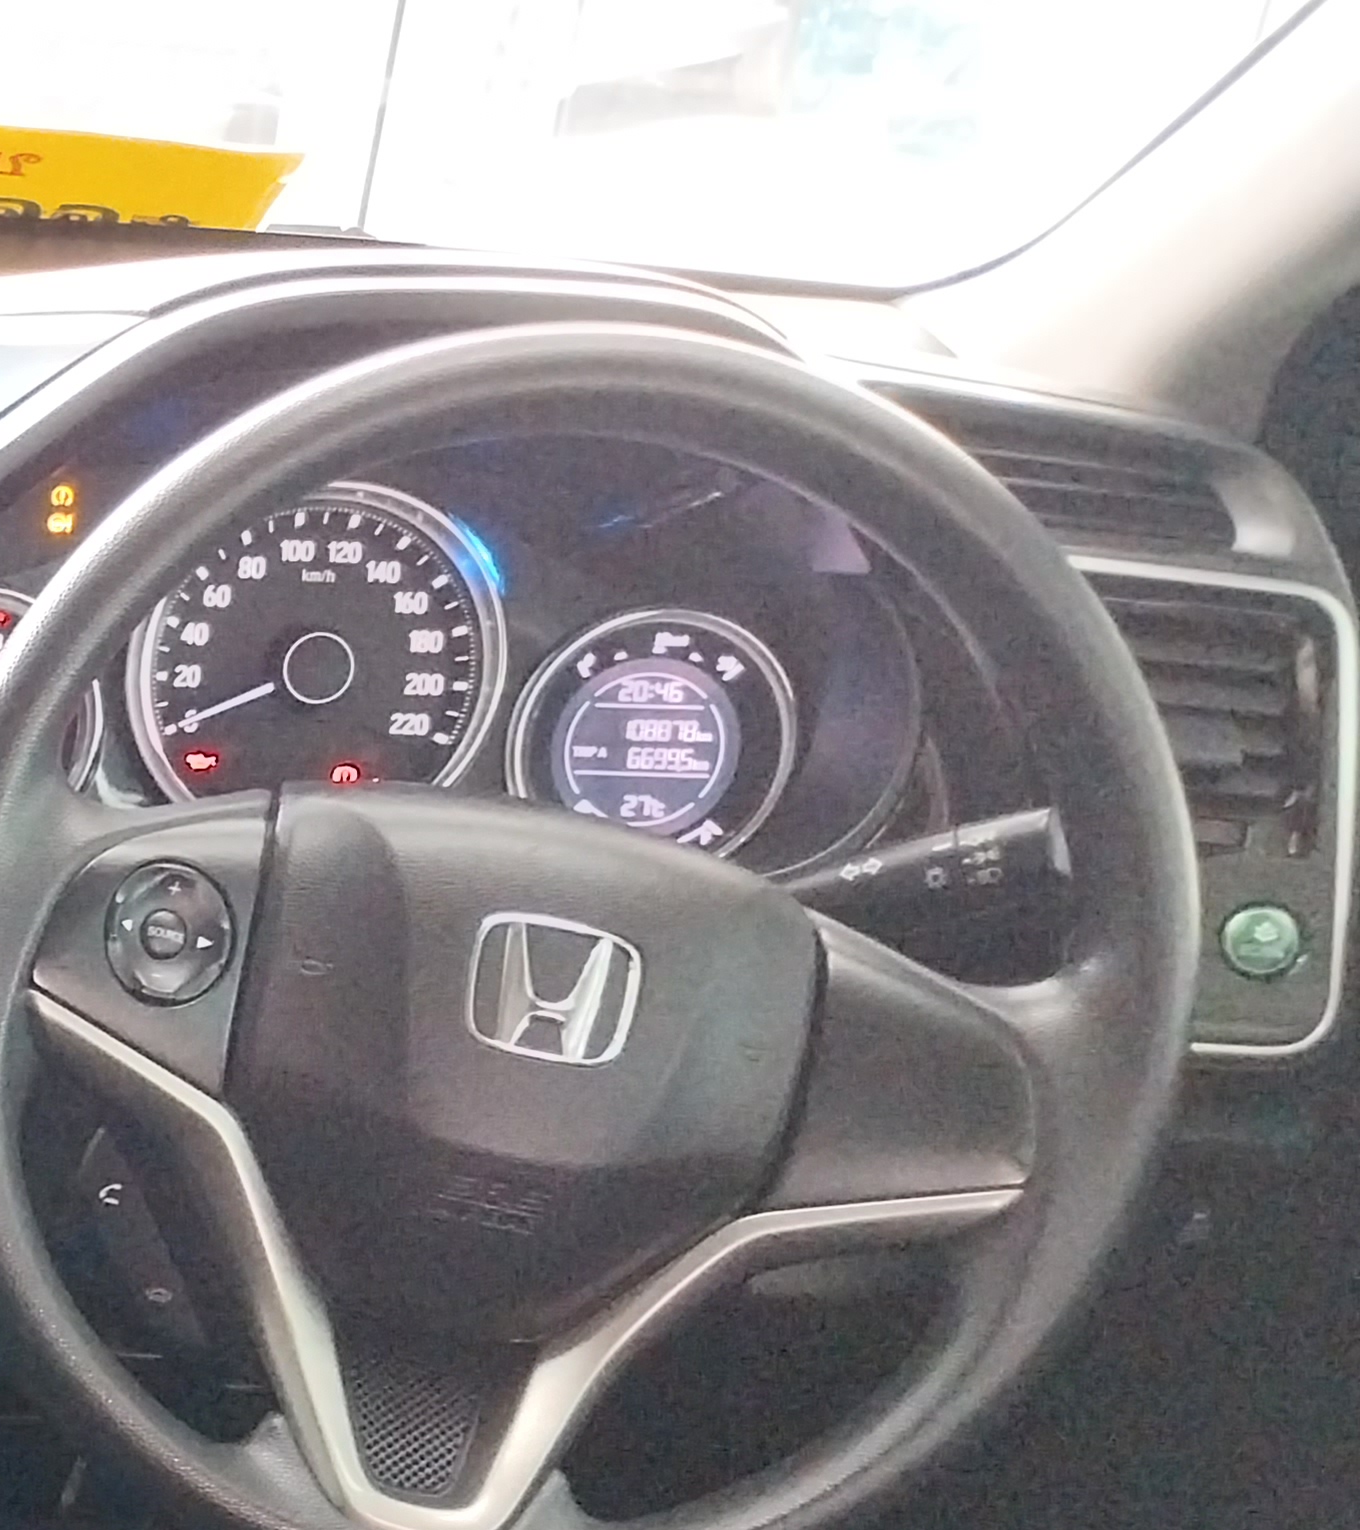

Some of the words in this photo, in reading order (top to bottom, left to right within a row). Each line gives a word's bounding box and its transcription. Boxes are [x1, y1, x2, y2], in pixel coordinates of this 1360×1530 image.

[280, 540, 315, 562] 100
[327, 541, 362, 563] 120
[238, 556, 266, 579] 80
[302, 569, 336, 583] km/h
[366, 560, 401, 584] 140
[203, 585, 231, 608] 60
[394, 592, 429, 615] 160
[181, 622, 209, 646] 40
[409, 630, 444, 653] 180
[173, 665, 201, 688] 20
[404, 673, 444, 696] 200
[618, 680, 684, 703] 20:46
[389, 713, 430, 736] 220
